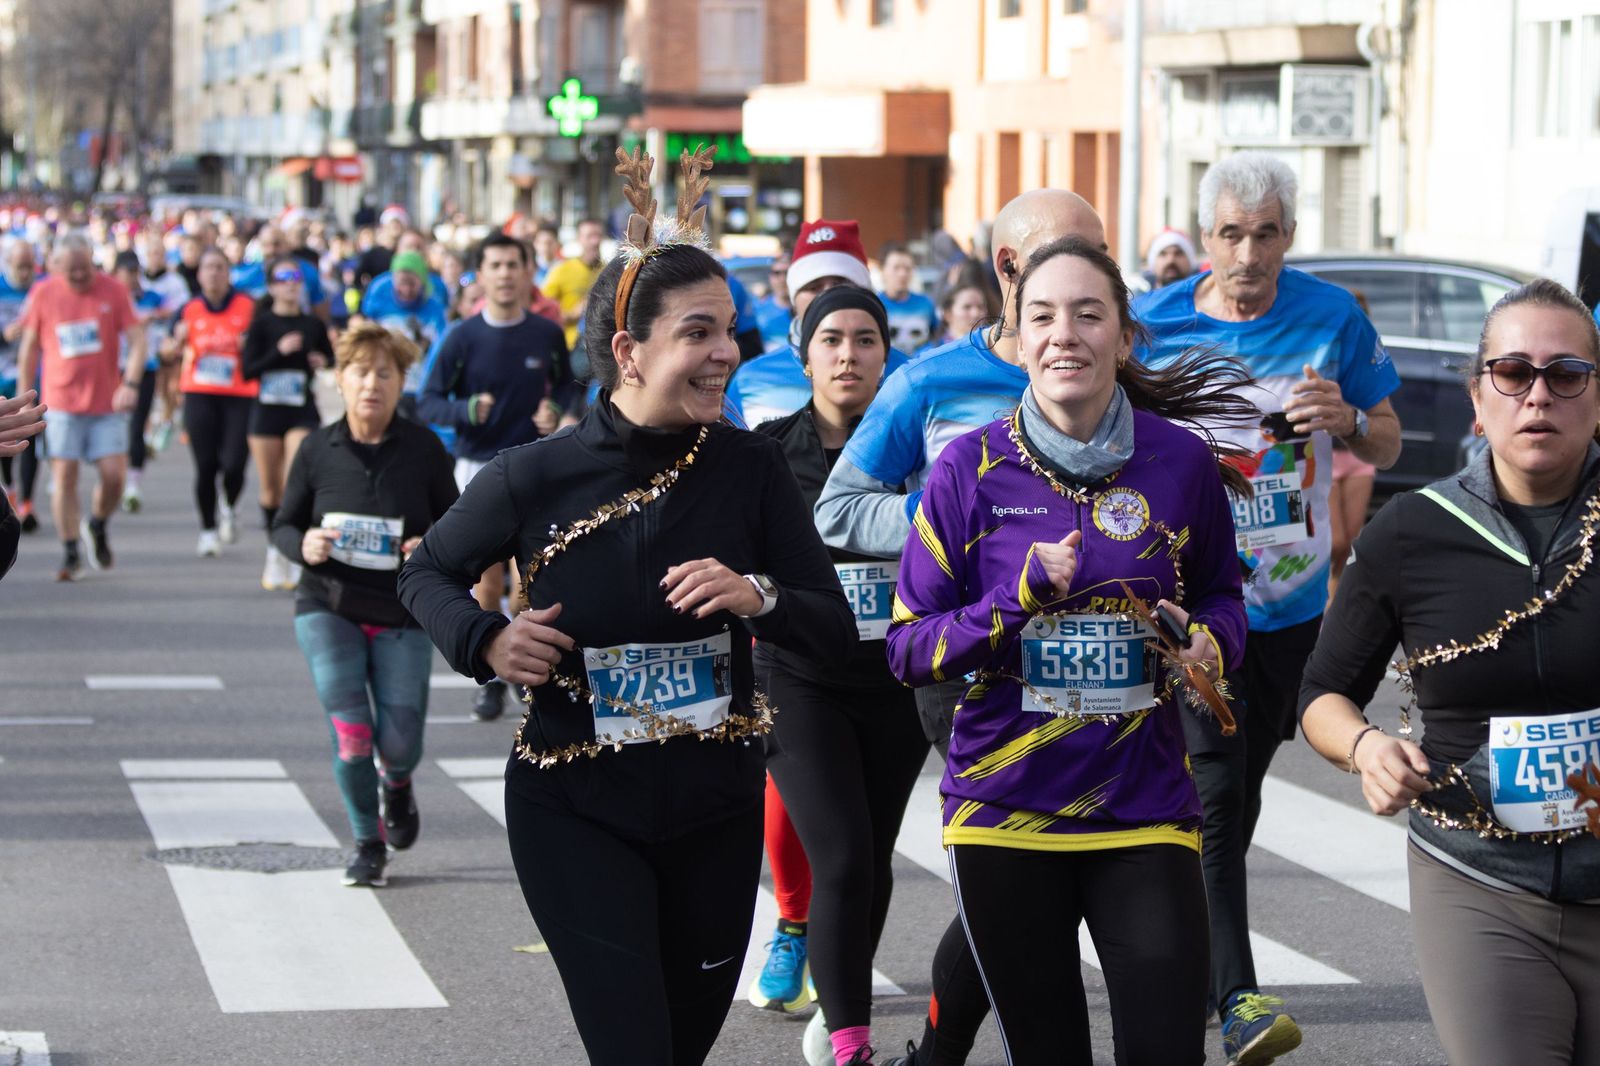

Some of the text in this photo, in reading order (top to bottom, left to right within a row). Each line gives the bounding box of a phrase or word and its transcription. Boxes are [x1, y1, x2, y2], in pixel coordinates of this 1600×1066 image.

[1253, 480, 1290, 492] TEL
[992, 505, 1048, 517] MAGLIA
[1235, 494, 1276, 527] 918
[342, 531, 382, 551] 296
[839, 568, 890, 581] ETEL
[843, 584, 877, 615] 93
[1059, 619, 1146, 637] SETEL
[625, 643, 717, 664] SETEL
[1041, 641, 1128, 681] 5336
[609, 659, 697, 713] 2239
[1083, 697, 1122, 705] Ayuntamiento
[1526, 717, 1600, 741] SETE
[1545, 790, 1576, 801] CAROL
